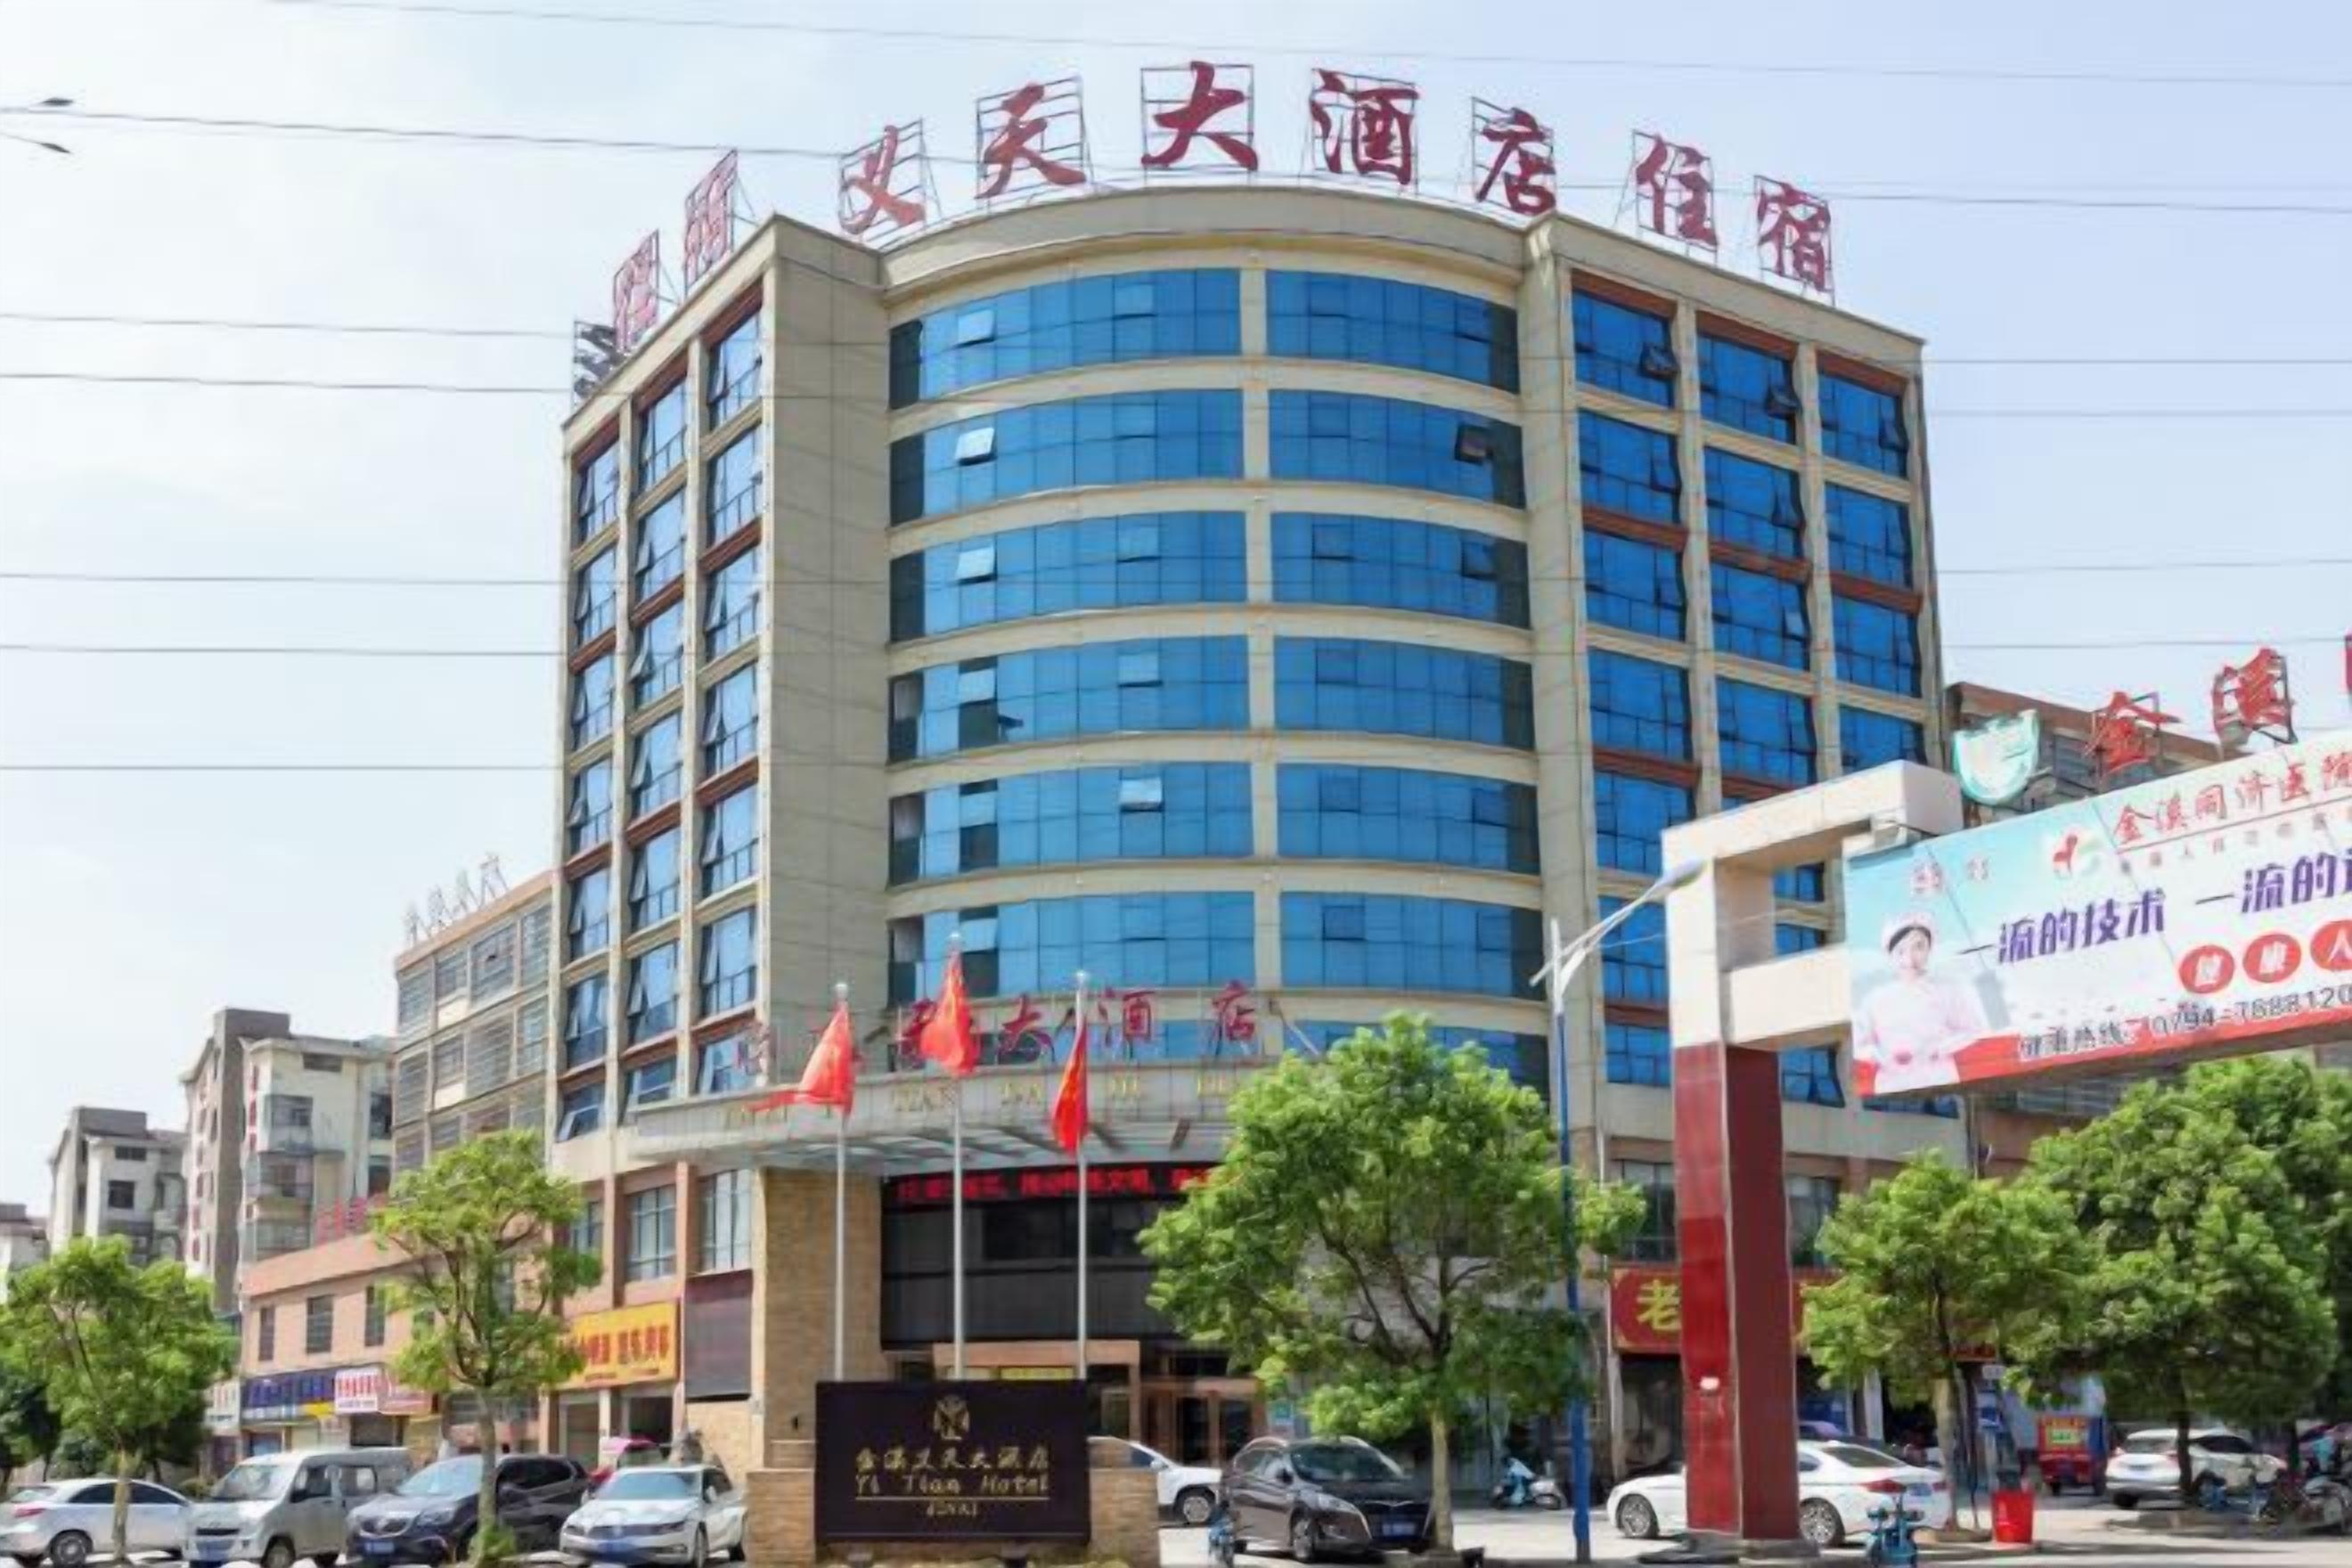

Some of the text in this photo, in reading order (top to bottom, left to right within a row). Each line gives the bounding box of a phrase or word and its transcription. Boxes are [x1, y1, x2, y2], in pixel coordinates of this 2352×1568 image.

[1636, 134, 1831, 291] 住宿
[2082, 647, 2352, 775] 金溪
[1958, 848, 2352, 962] 一流的技术 一流的
